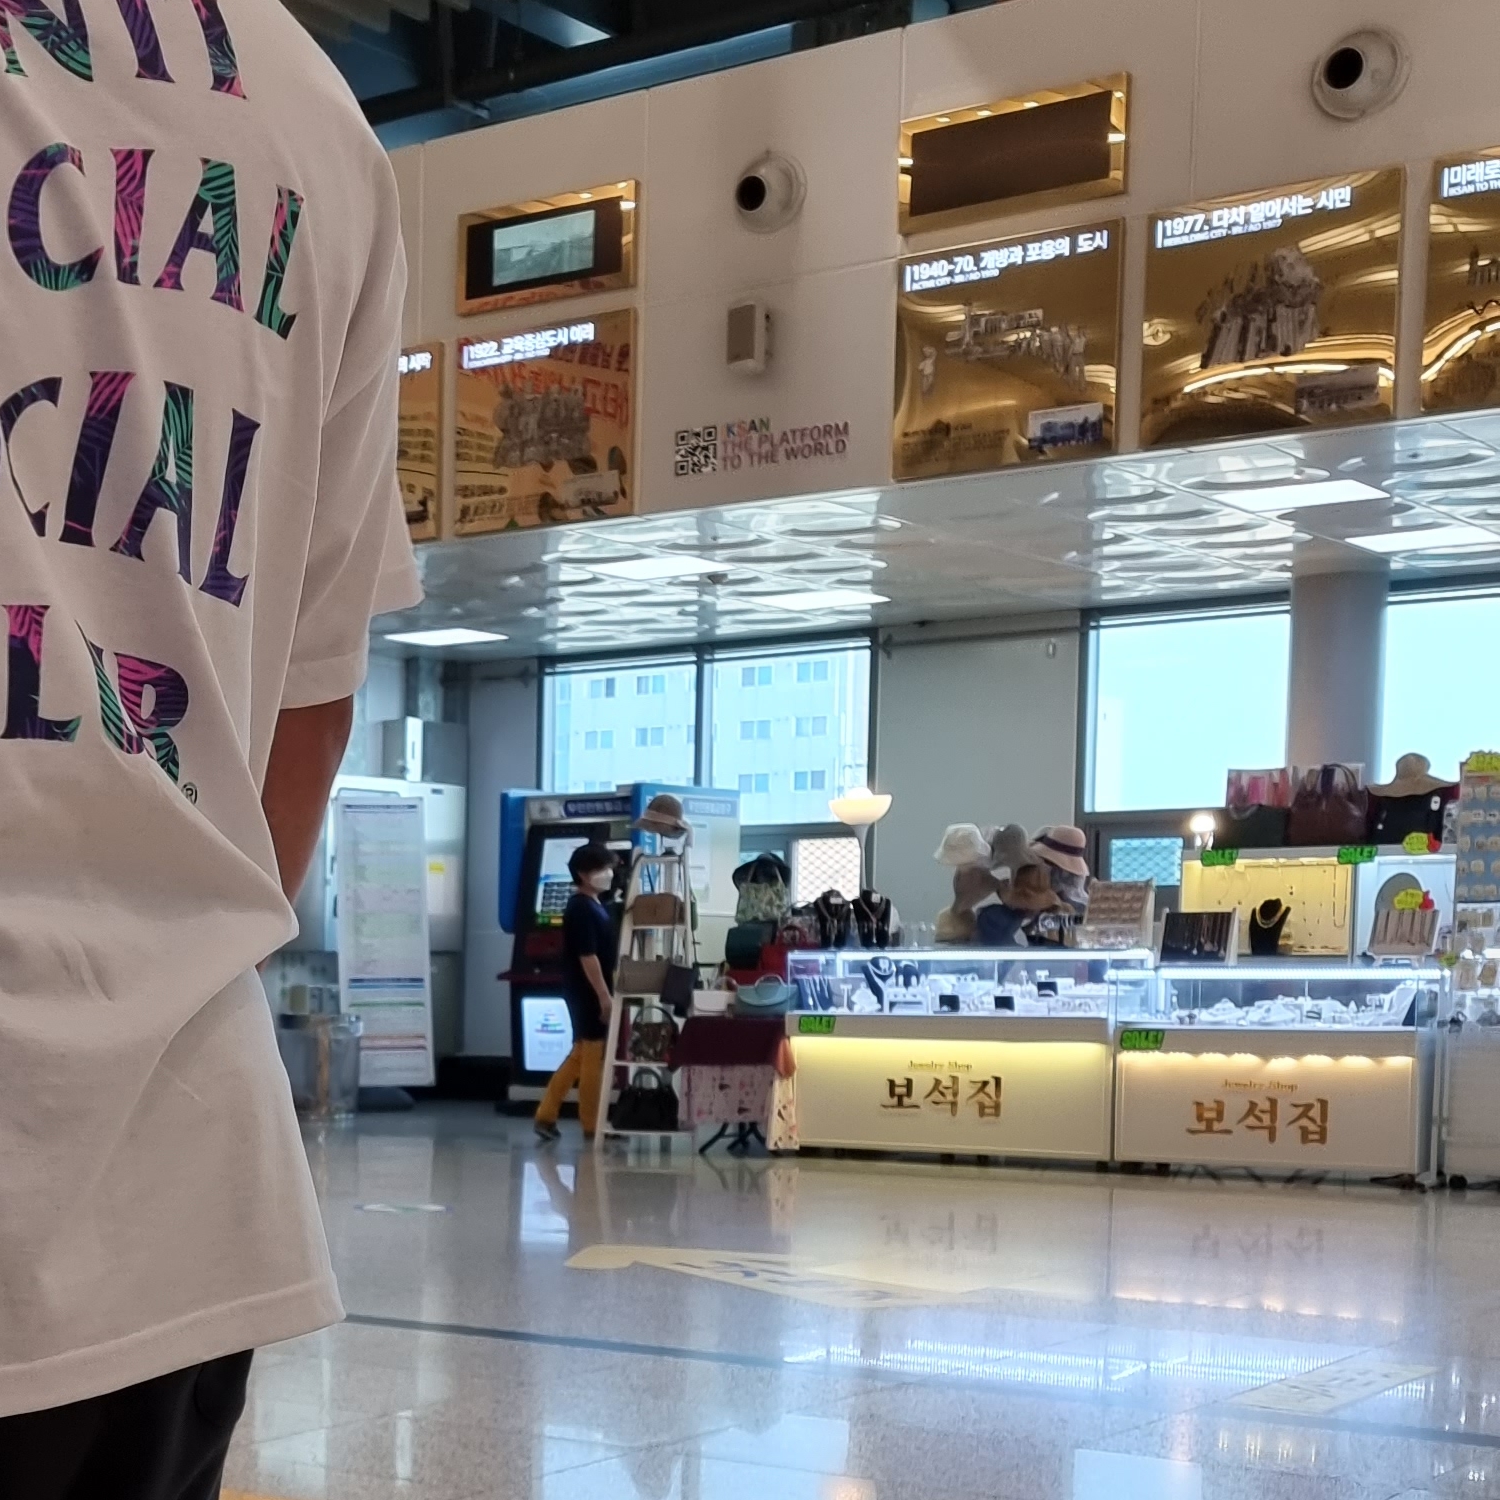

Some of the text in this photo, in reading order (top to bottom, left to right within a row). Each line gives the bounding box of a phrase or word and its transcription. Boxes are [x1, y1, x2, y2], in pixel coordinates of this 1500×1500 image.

[1164, 185, 1351, 237] 1977. 다시 일어서는 시민
[912, 229, 1109, 281] 1940-70. 개방과 포용의 도시
[721, 439, 848, 471] TO THE WORLD
[758, 421, 850, 449] PLATFORM
[881, 1074, 1002, 1118] 보석집
[1186, 1096, 1329, 1145] 보석집
